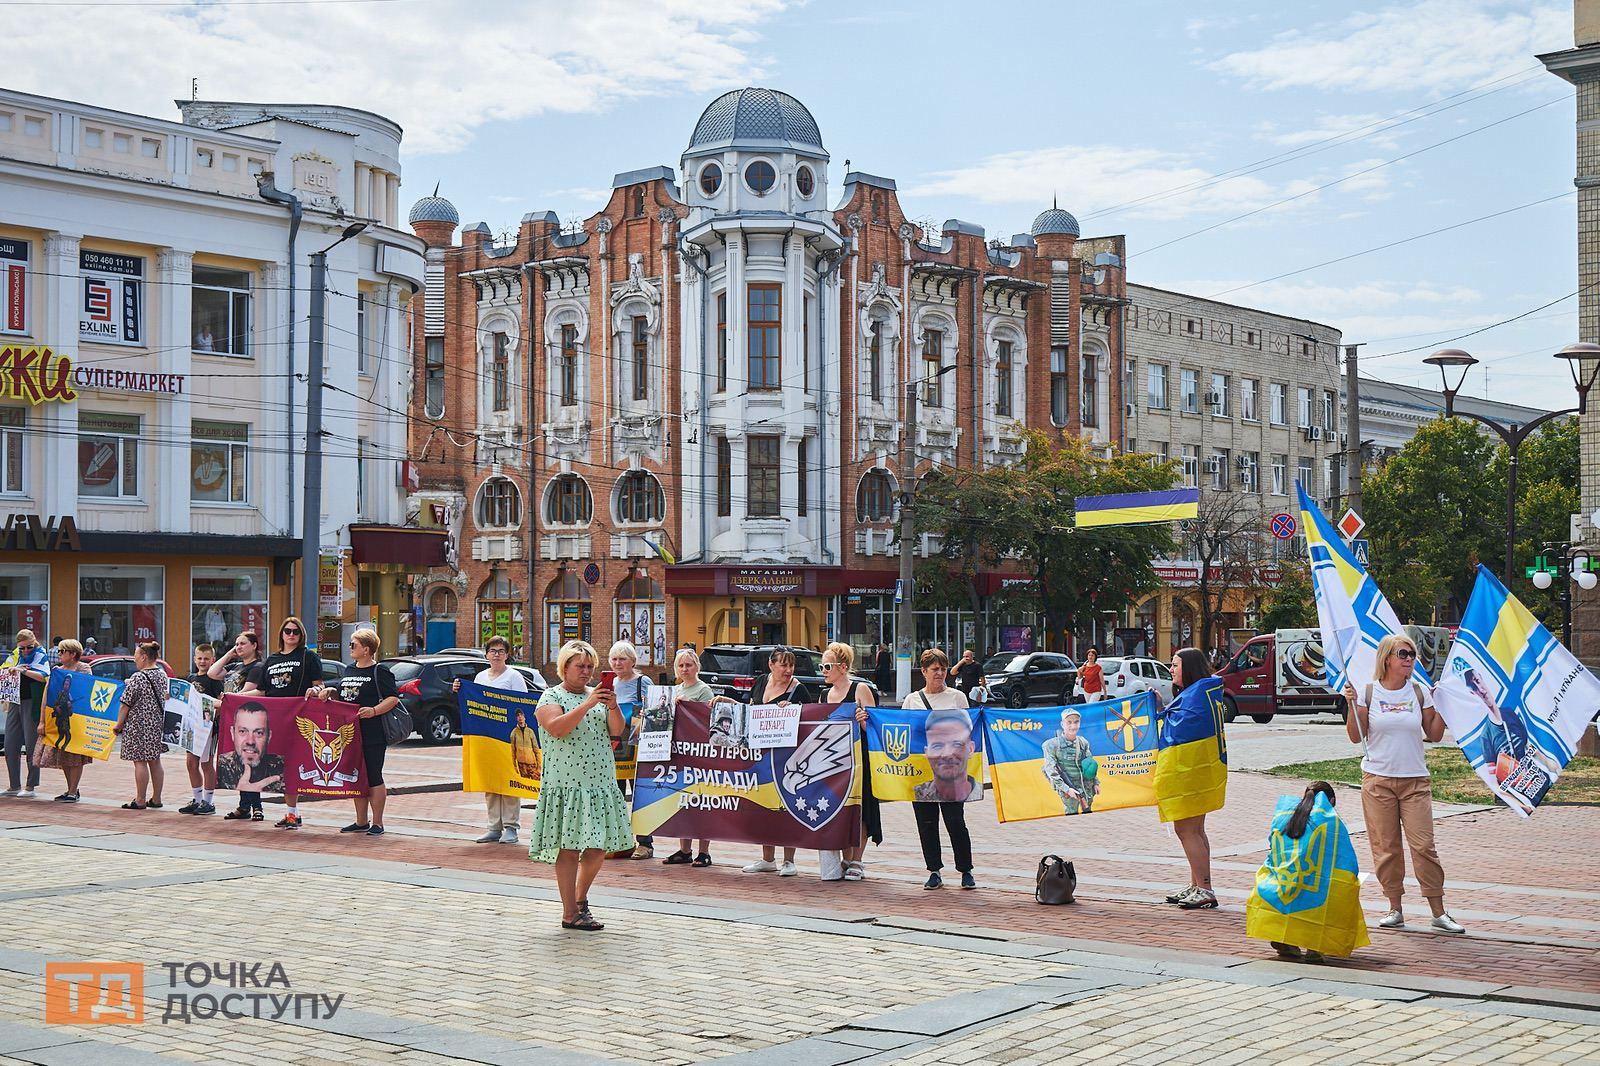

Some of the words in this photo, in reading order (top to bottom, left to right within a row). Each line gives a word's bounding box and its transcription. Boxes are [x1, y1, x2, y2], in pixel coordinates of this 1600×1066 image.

[85, 254, 98, 263] 050
[100, 256, 113, 265] 460
[116, 259, 123, 267] 11
[126, 260, 134, 268] 11
[85, 263, 134, 274] exline.com.ua
[80, 321, 117, 334] EXLINE
[75, 366, 185, 394] СУПЕРМАРКЕТ
[730, 576, 803, 585] ДЗЕРКАЛЬНИЙ
[760, 720, 786, 731] ЕДУАРД
[990, 718, 1043, 732] «Мей»
[1122, 753, 1153, 761] бригада
[876, 763, 923, 777] «МЕЙ»
[1116, 760, 1157, 769] батальйон
[653, 765, 678, 784] 25
[683, 766, 759, 794] БРИГАДИ
[678, 793, 740, 811] ДОДОМУ
